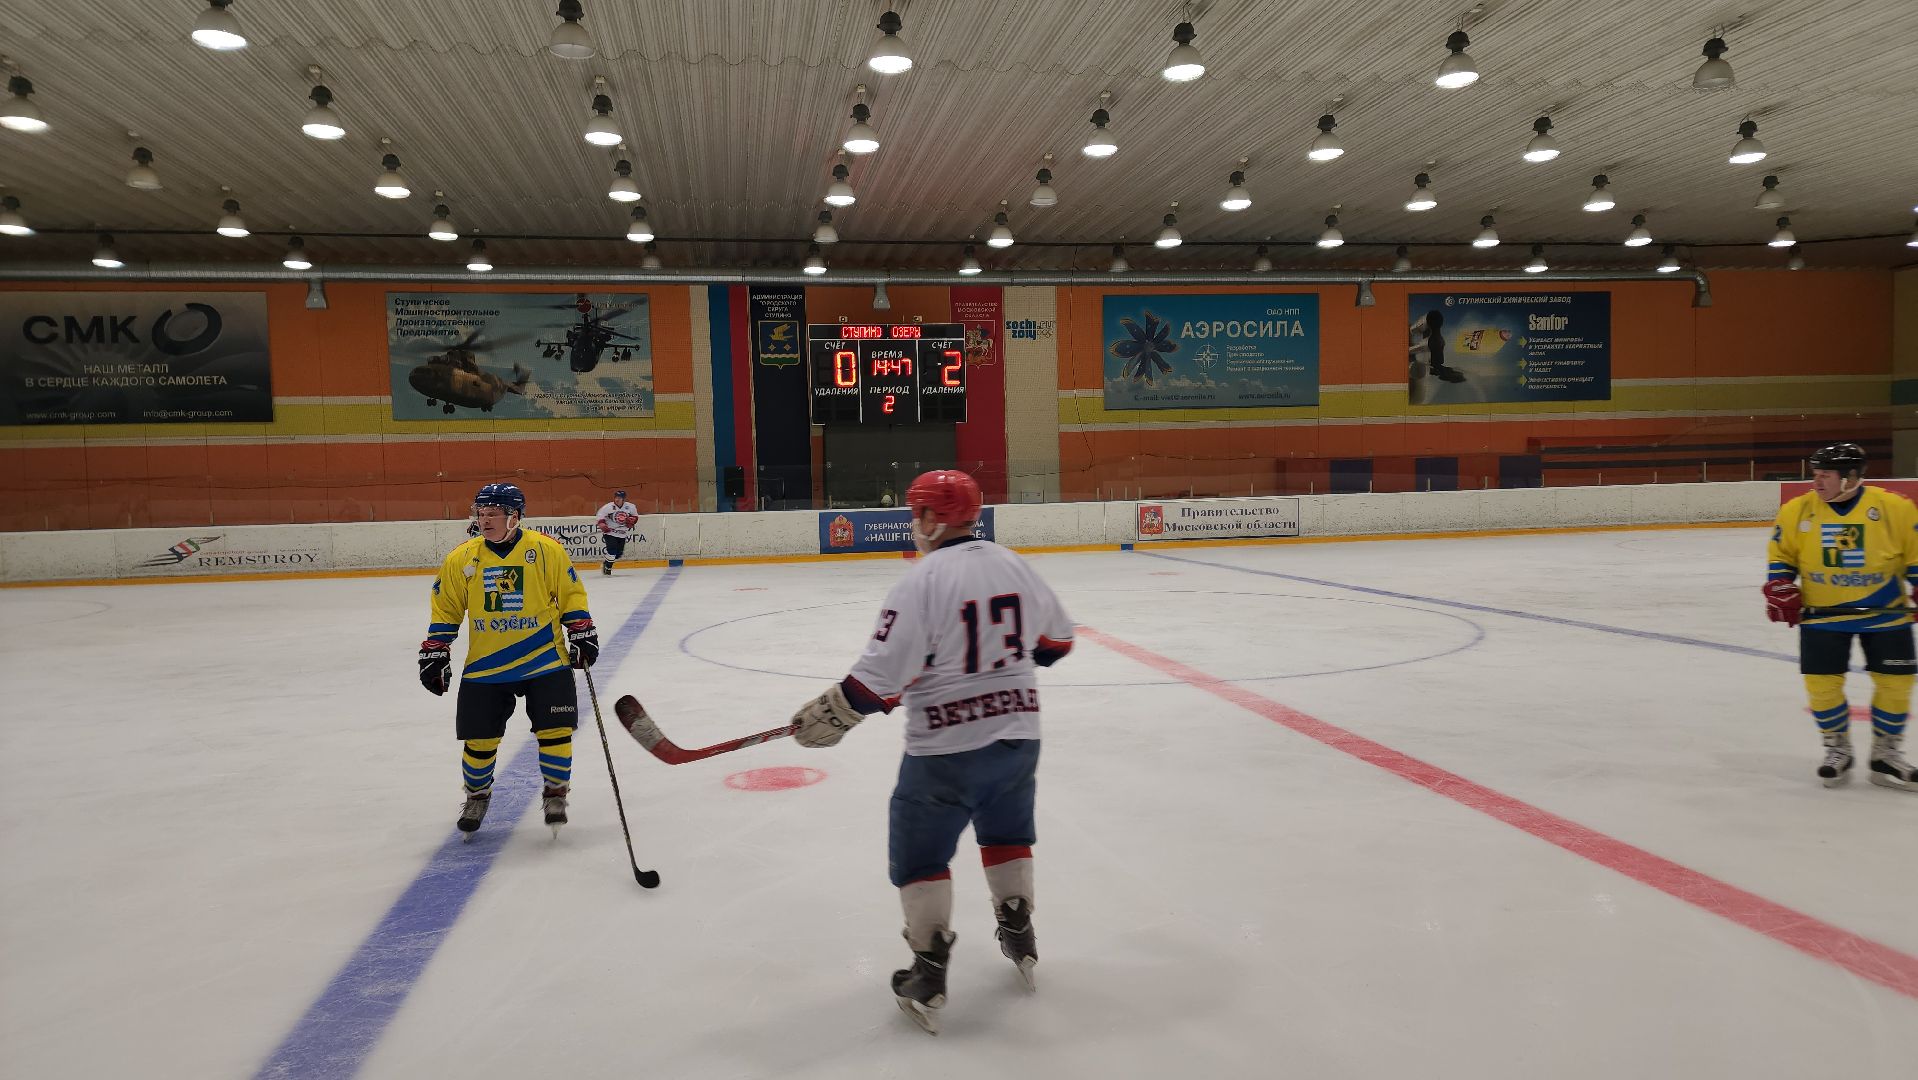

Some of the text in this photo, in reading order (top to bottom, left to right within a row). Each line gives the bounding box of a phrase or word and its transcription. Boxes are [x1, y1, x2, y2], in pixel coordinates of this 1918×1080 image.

[394, 298, 450, 307] Ступинское
[1549, 296, 1571, 304] ЗАВОД
[1528, 313, 1568, 331] Sanfor
[22, 315, 140, 345] СМК
[396, 328, 460, 337] Предприятие
[842, 326, 921, 338] СТУПИНО ОЗЕРЫ
[1180, 320, 1305, 339] АЭРОСИЛА
[871, 351, 904, 359] ВРЕМЯ
[84, 364, 169, 374] НАШ МЕТАЛЛ
[836, 351, 857, 387] 0
[872, 358, 912, 376] 14:47
[943, 351, 962, 387] 2
[25, 375, 228, 388] В СЕРДЦЕ КАЖДОГО САМОЛЕТА
[815, 387, 859, 396] УДАЛЕНИЯ
[870, 386, 910, 395] ПЕРИОД
[922, 386, 965, 395] УДАЛЕНИЯ
[884, 395, 895, 413] 2
[1181, 507, 1280, 519] Правительство
[1164, 519, 1297, 532] Московской области
[198, 553, 319, 567] REMSTROY
[960, 593, 1026, 674] 13
